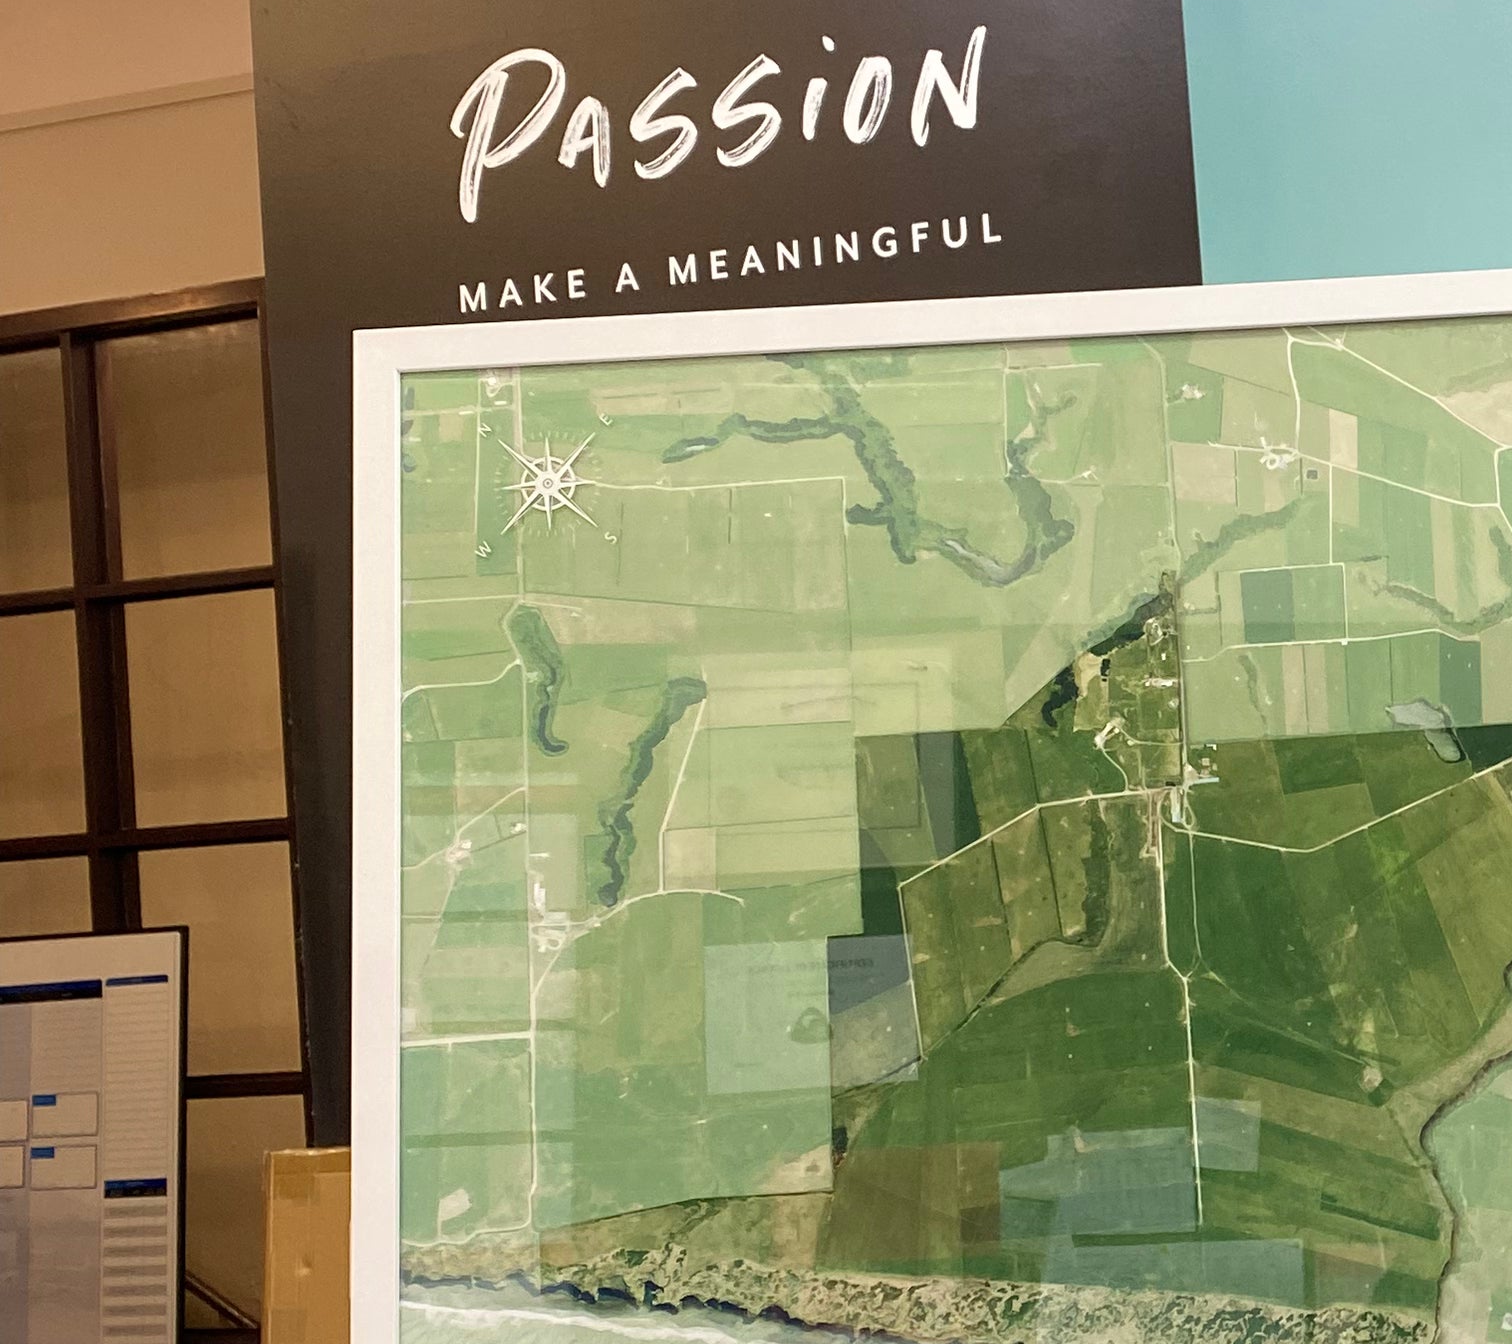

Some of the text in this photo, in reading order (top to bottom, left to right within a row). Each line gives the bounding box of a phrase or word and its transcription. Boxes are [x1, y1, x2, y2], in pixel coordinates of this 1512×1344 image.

[458, 213, 1003, 313] MAKE A MEANINGFUL
